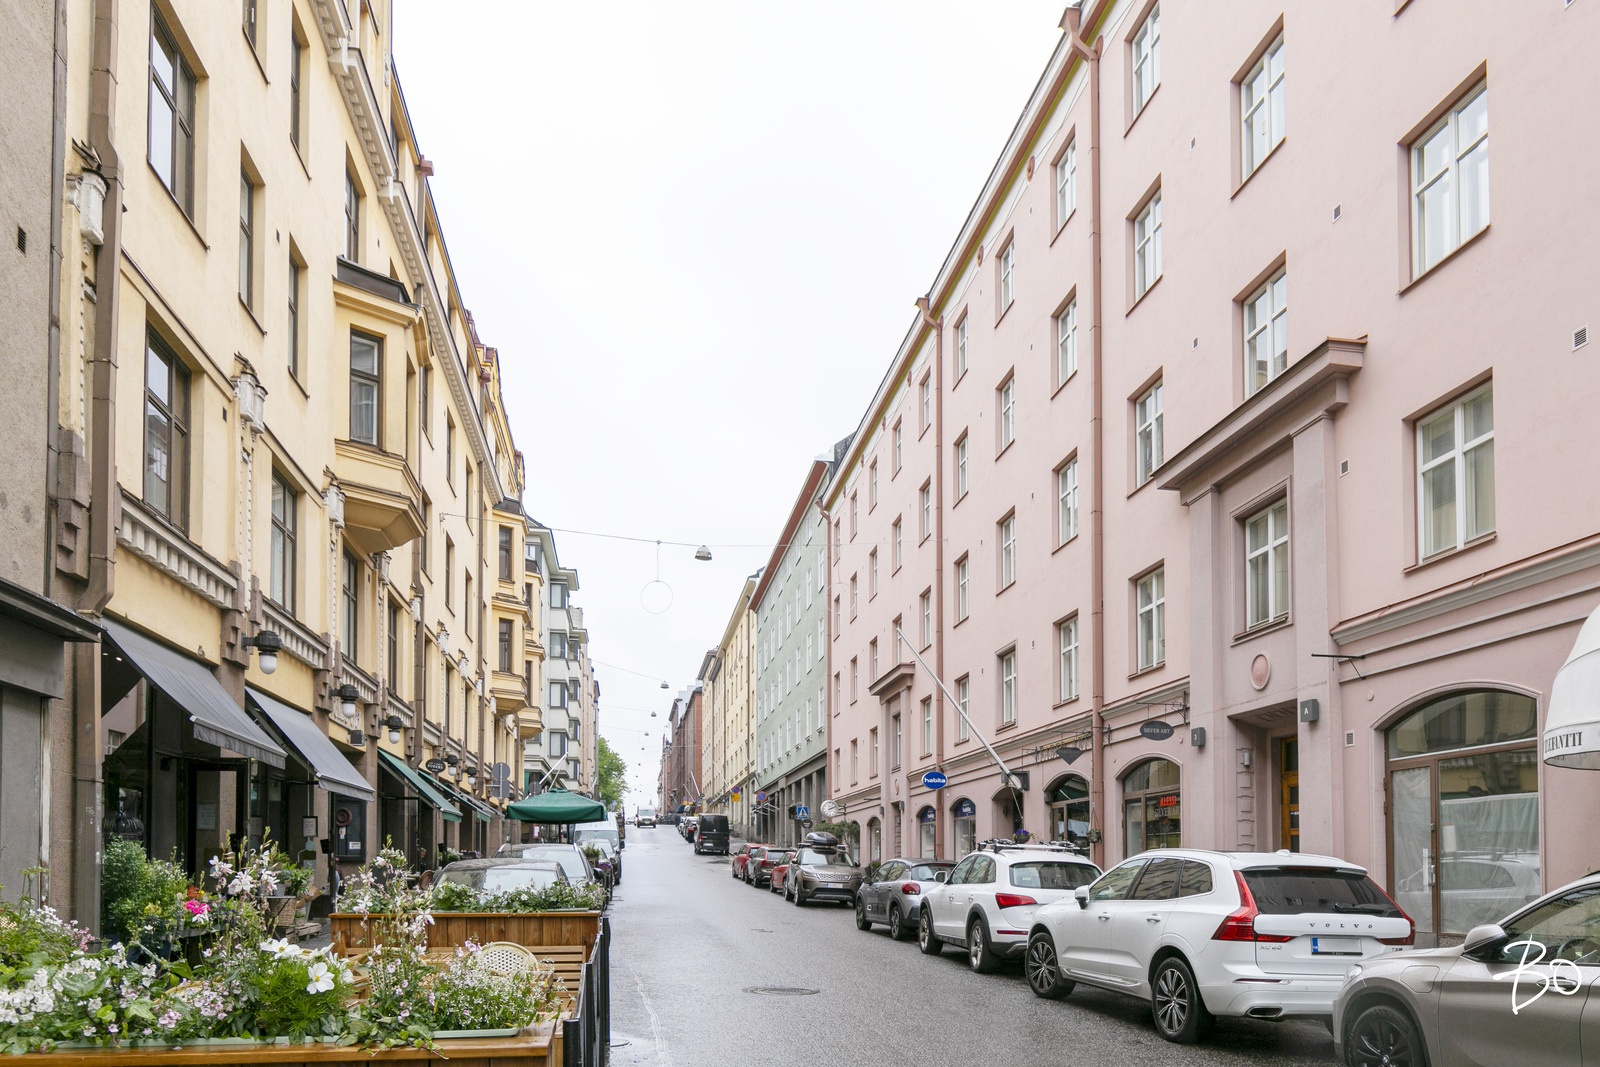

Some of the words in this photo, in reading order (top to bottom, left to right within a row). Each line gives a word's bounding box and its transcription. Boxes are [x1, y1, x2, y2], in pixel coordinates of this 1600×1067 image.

[1304, 707, 1309, 715] A
[1160, 796, 1176, 807] ALESSI
[1154, 806, 1172, 818] SILVER
